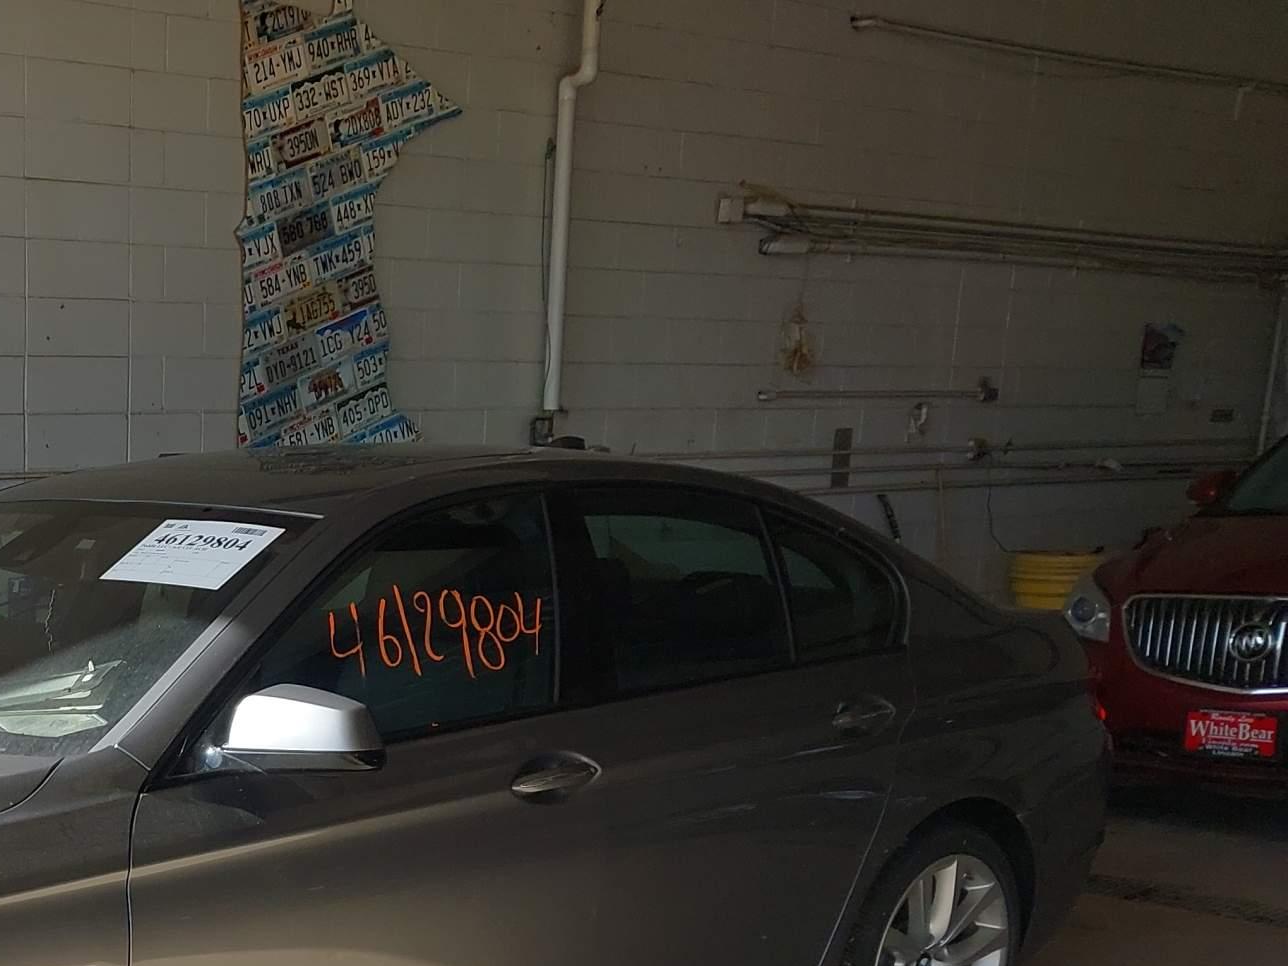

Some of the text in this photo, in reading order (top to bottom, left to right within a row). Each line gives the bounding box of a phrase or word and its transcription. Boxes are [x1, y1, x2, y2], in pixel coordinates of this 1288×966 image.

[307, 37, 330, 62] 940
[349, 66, 371, 92] 369
[411, 88, 433, 113] 232
[311, 169, 335, 196] 524
[336, 199, 358, 222] 448
[342, 239, 362, 265] 459
[276, 341, 299, 356] TEXAS
[356, 355, 378, 380] 503
[248, 404, 272, 430] 091
[154, 533, 254, 552] 46129804
[327, 583, 542, 680] 46129804
